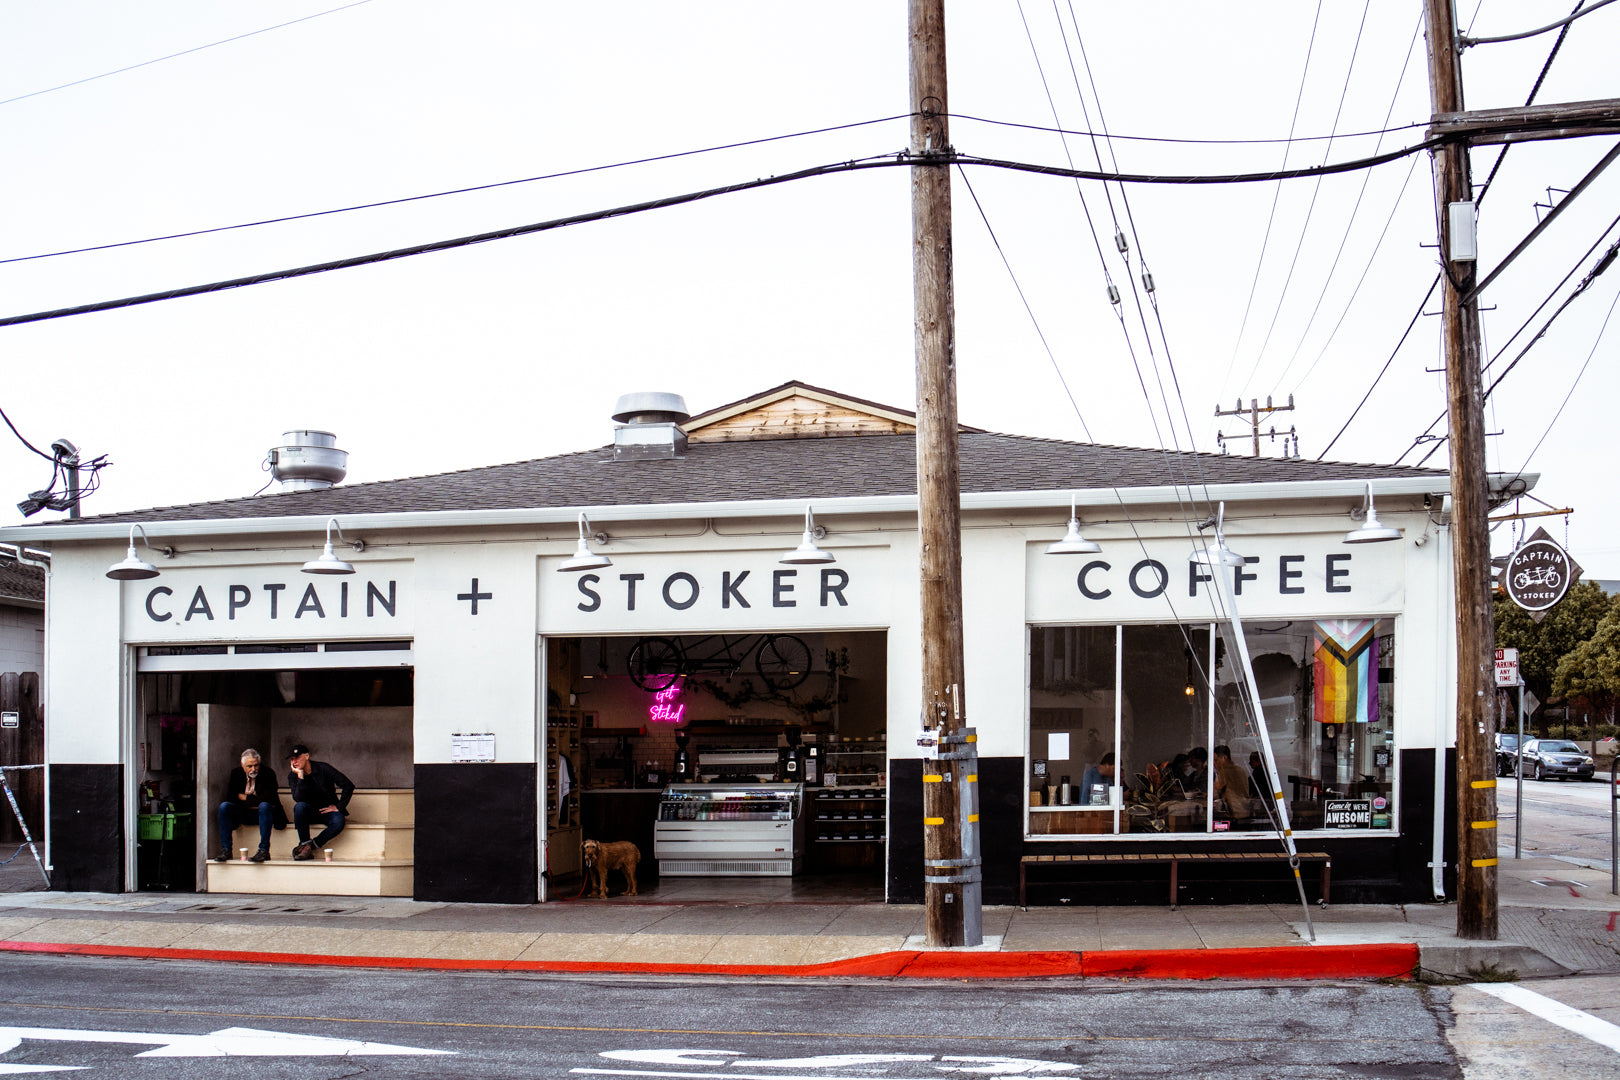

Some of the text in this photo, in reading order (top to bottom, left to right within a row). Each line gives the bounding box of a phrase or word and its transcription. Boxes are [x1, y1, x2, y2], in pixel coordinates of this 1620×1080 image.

[1515, 551, 1562, 565] CAPTAIN
[145, 553, 1352, 622] CAPTAIN + STOKER COFFEE
[1495, 650, 1503, 659] NO
[656, 685, 680, 703] Get
[1326, 812, 1370, 823] AWESOME
